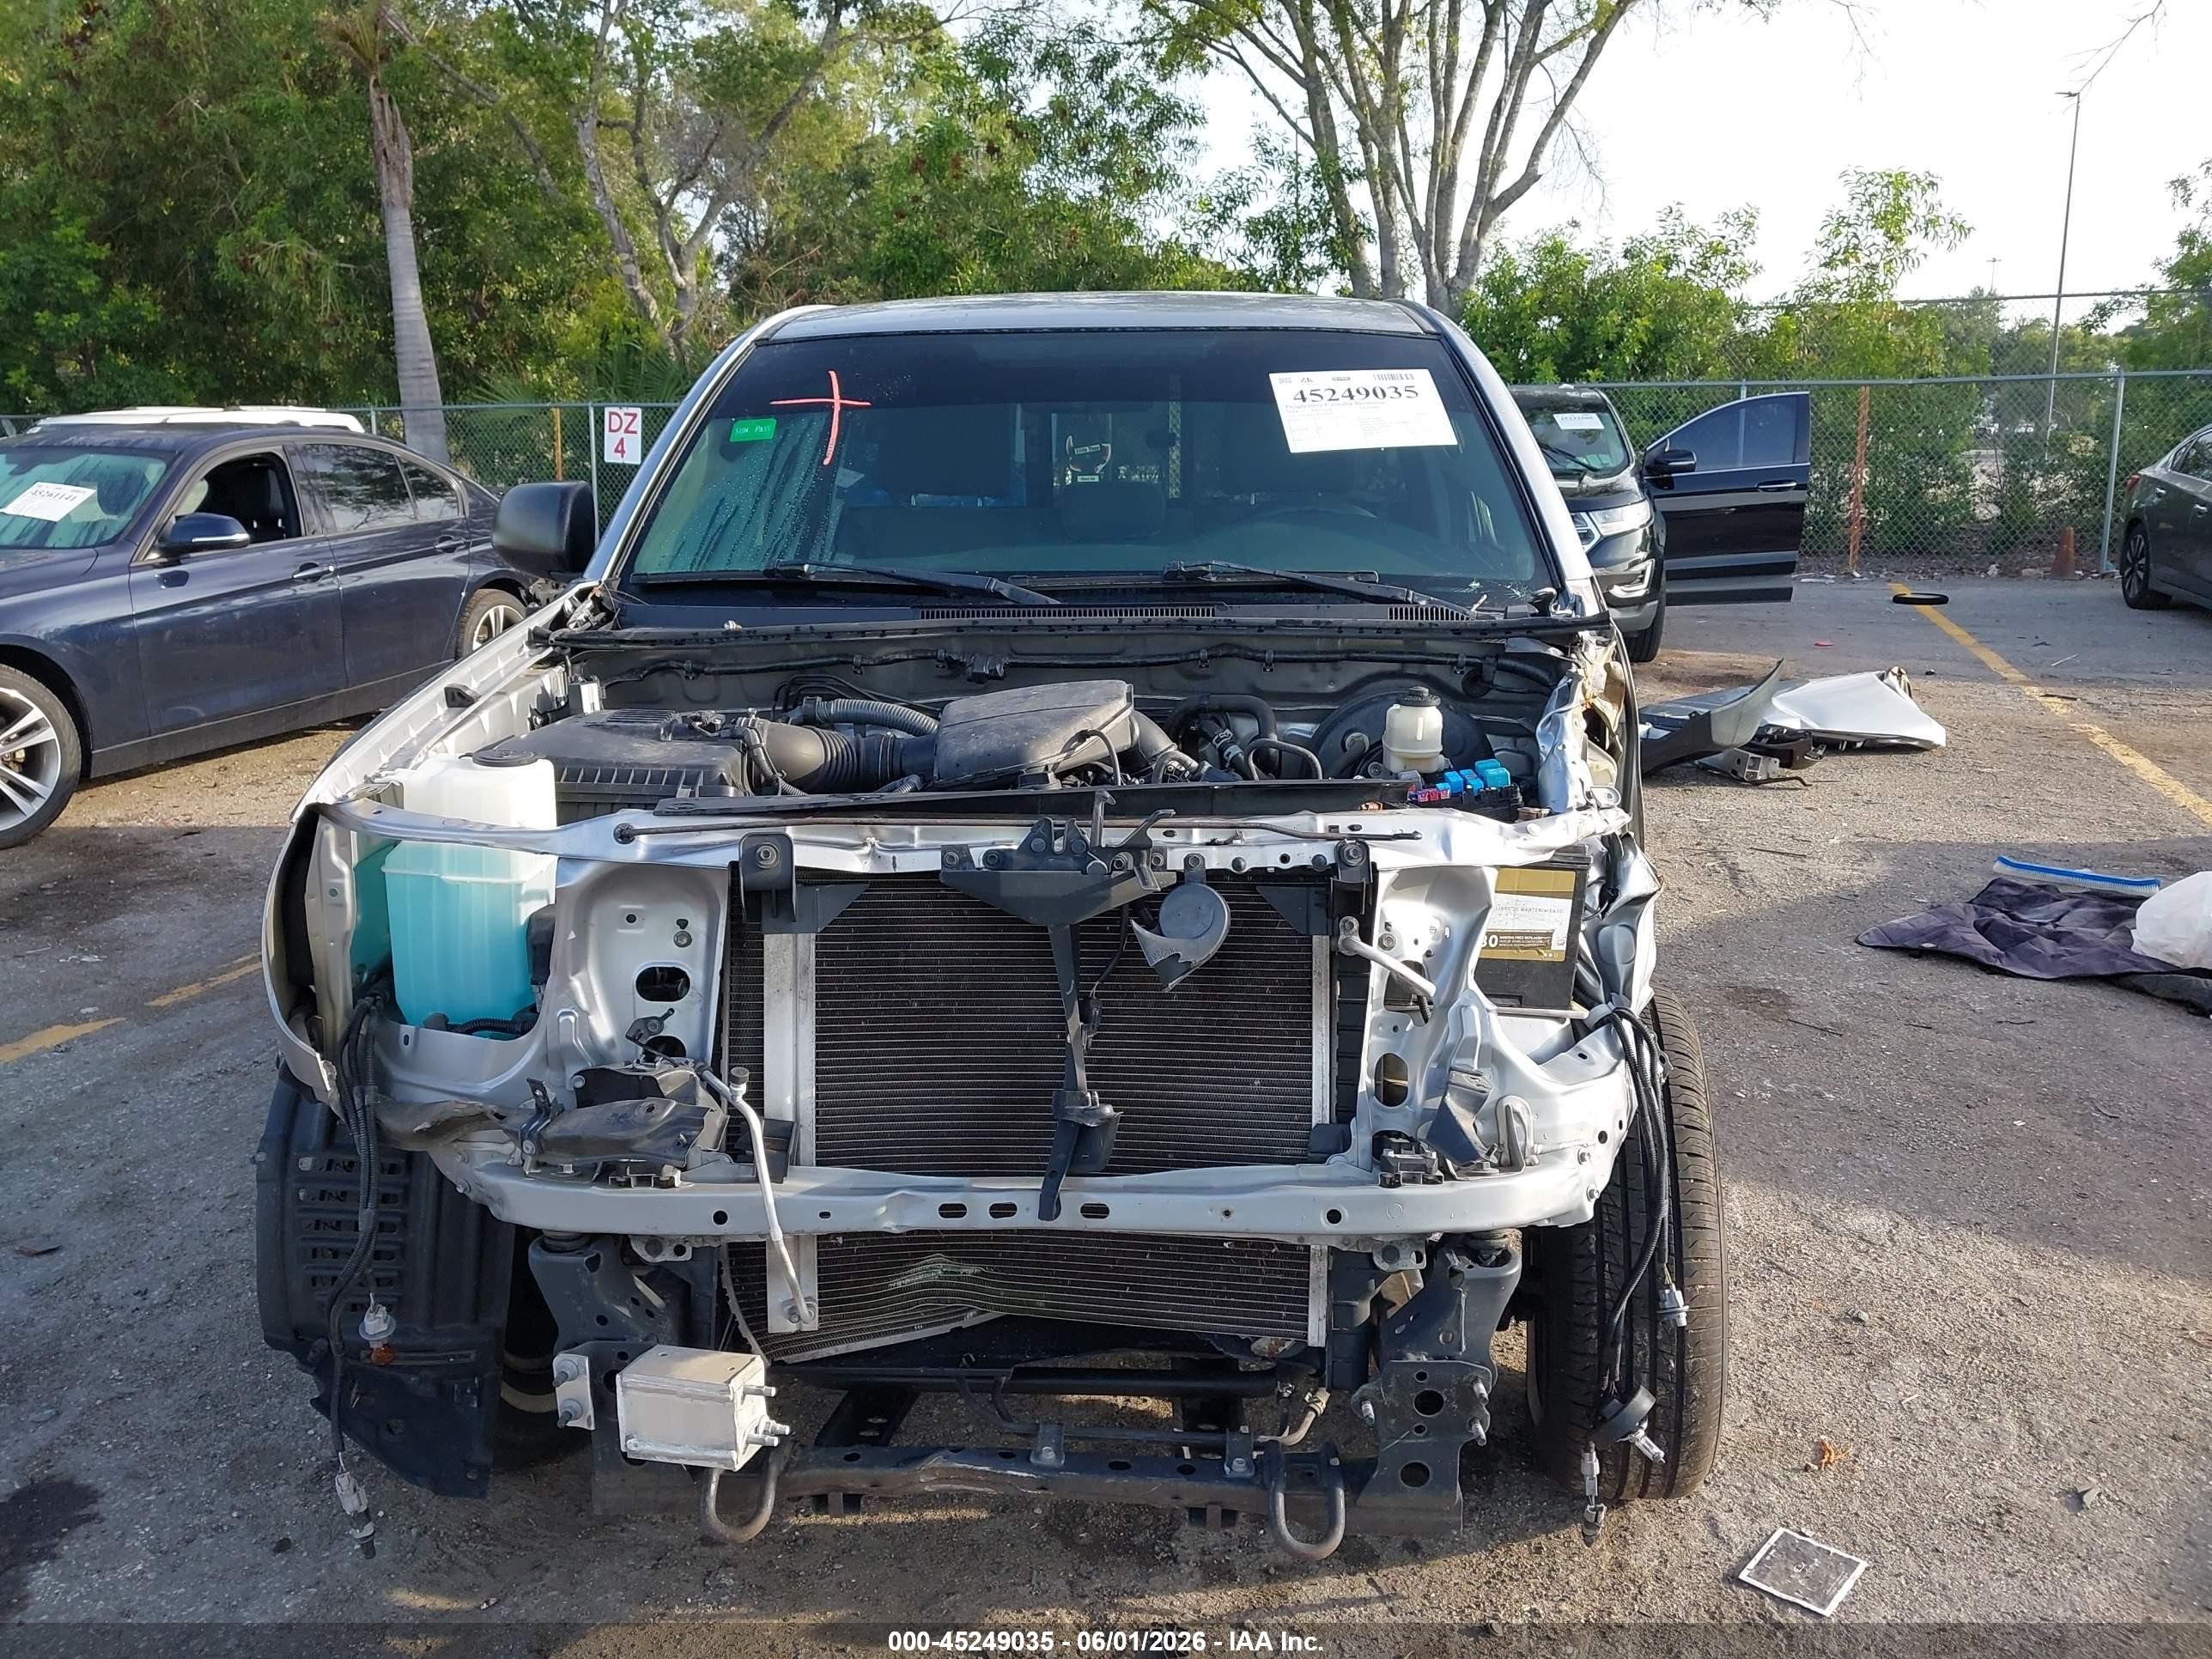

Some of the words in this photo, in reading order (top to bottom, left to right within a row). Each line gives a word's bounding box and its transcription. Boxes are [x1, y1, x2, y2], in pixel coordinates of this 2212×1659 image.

[1293, 386, 1419, 403] 45249035
[608, 411, 638, 434] DZ
[613, 437, 626, 459] 4
